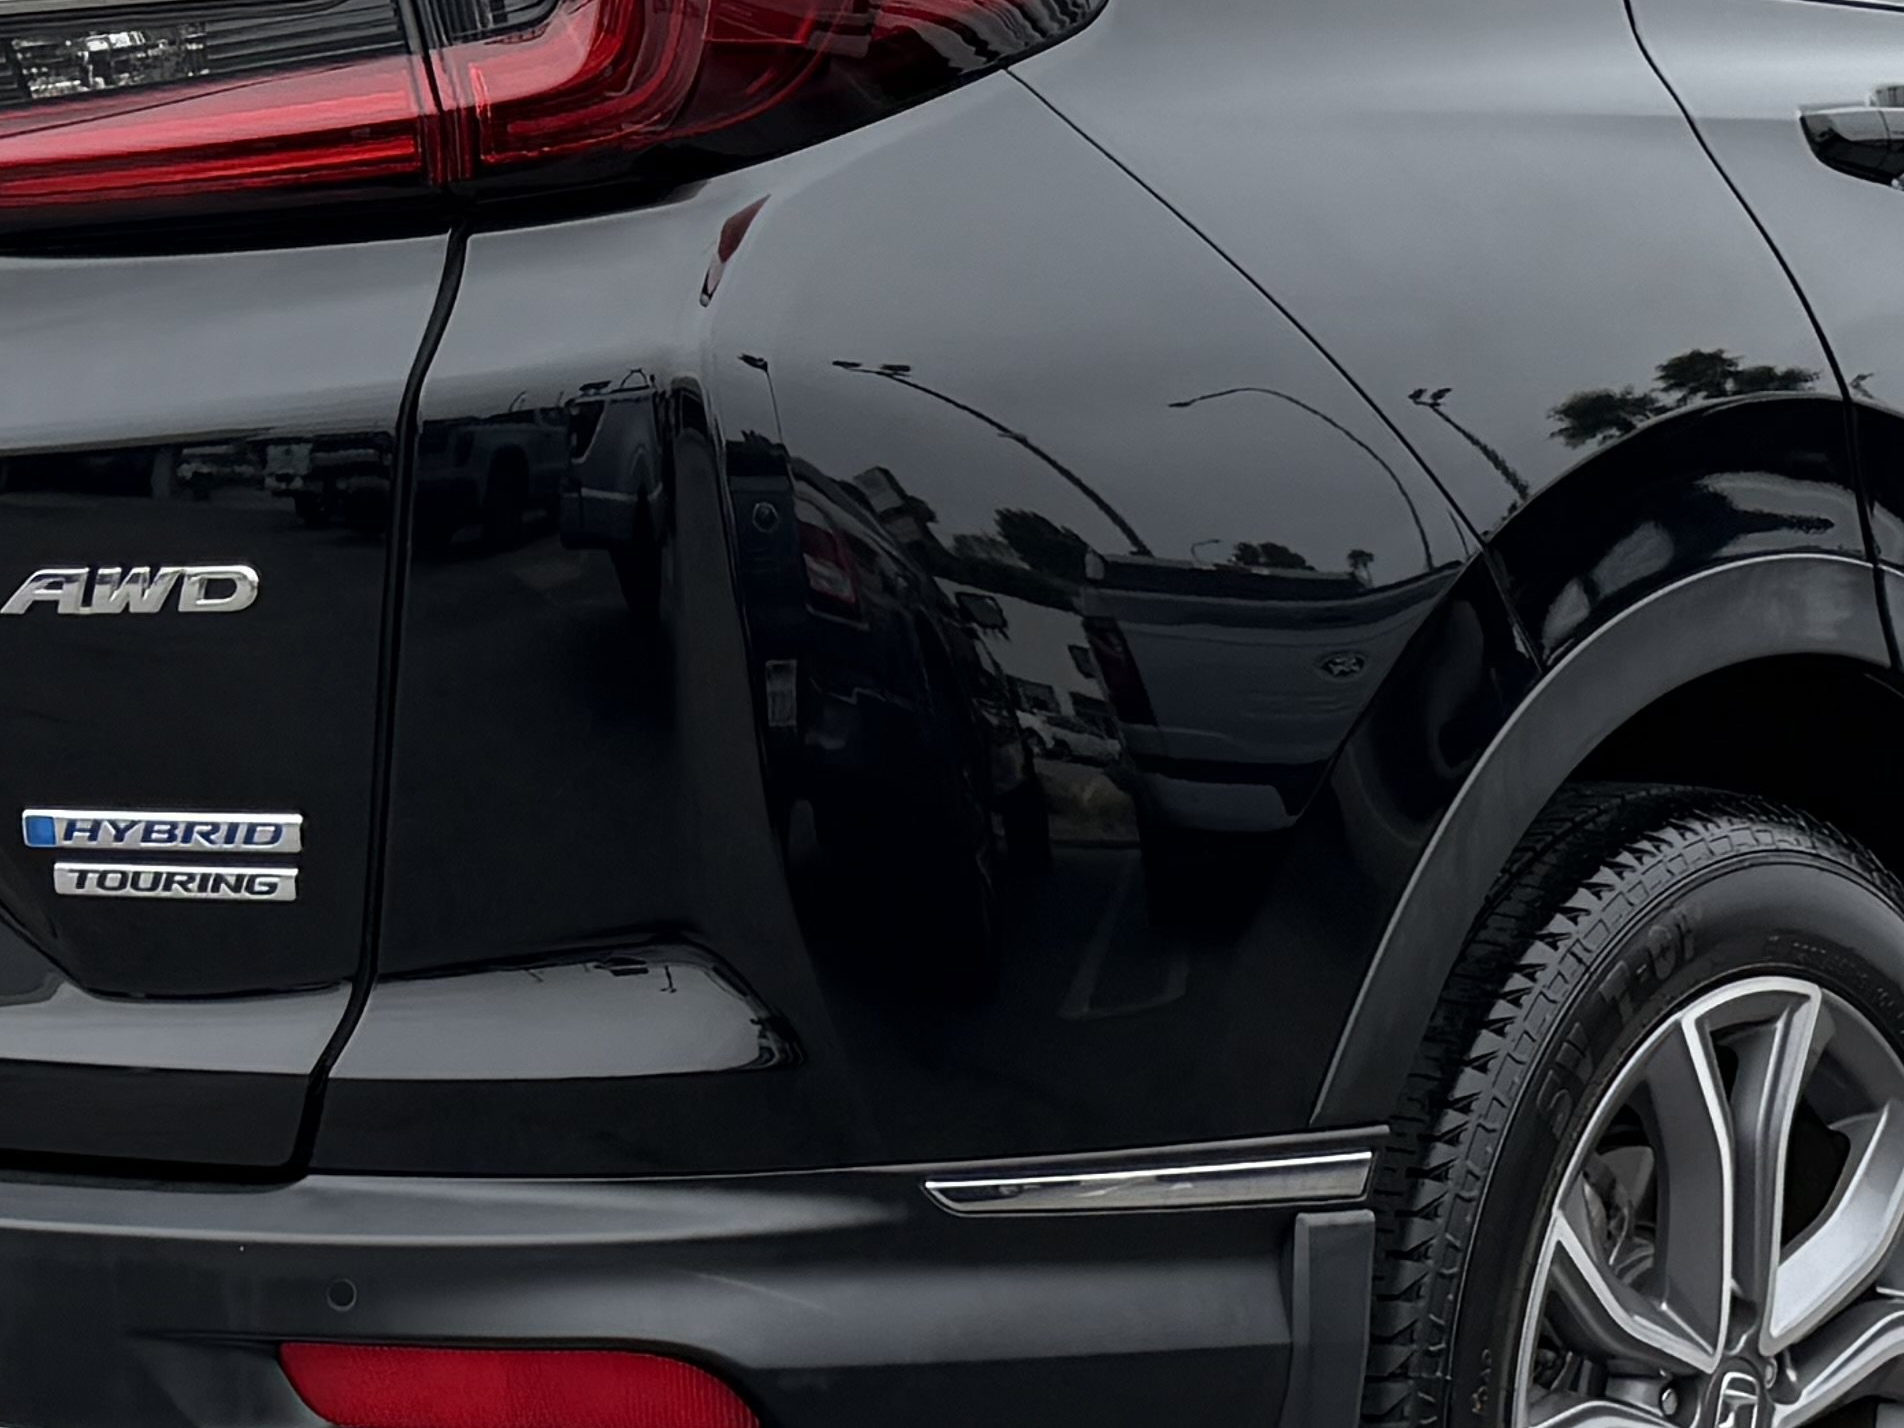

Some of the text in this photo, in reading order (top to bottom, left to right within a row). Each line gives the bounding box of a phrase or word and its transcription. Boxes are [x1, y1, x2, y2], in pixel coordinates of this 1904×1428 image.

[0, 564, 259, 615] AWD
[62, 818, 284, 848] HYBRID
[67, 868, 279, 896] TOURING
